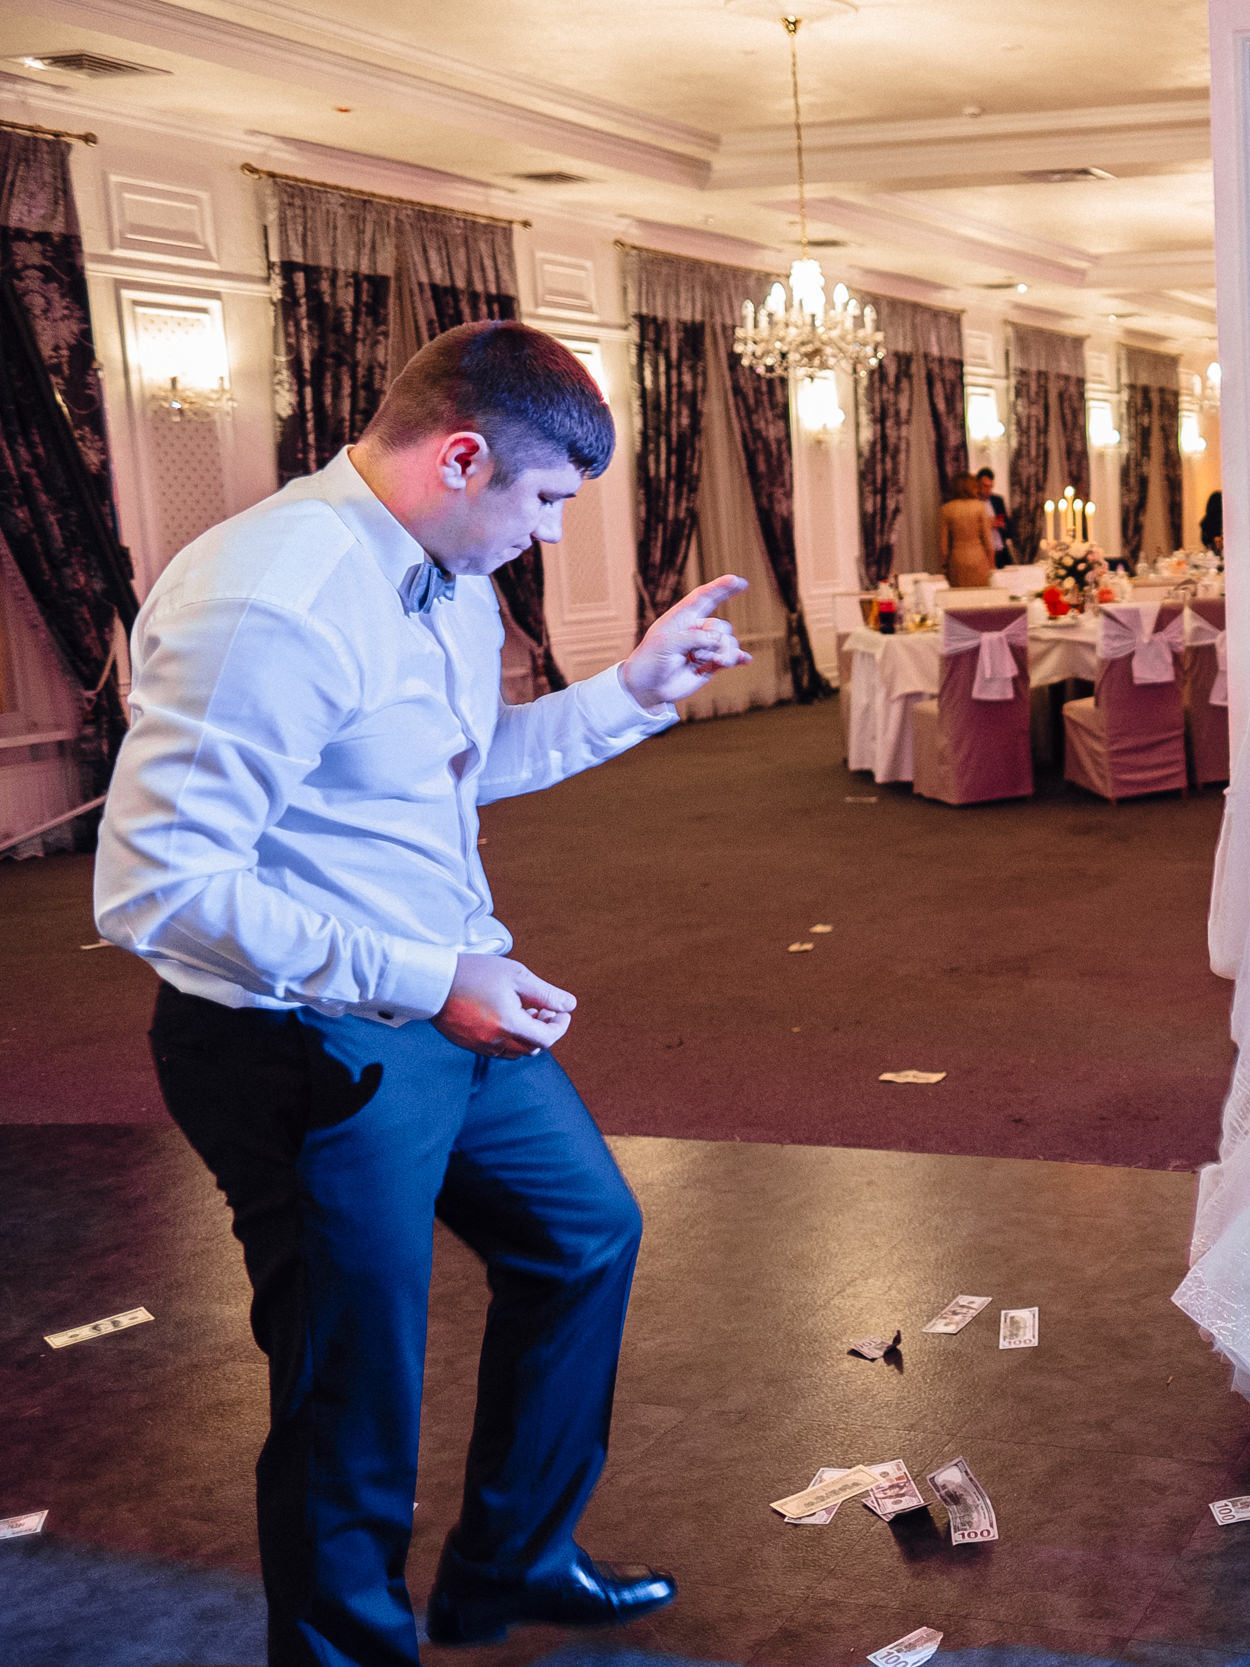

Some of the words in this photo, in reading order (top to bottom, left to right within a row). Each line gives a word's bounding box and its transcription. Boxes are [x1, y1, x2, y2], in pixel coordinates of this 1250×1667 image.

[1008, 1338, 1032, 1346] 100
[1216, 1503, 1236, 1521] 100
[957, 1529, 991, 1540] 100
